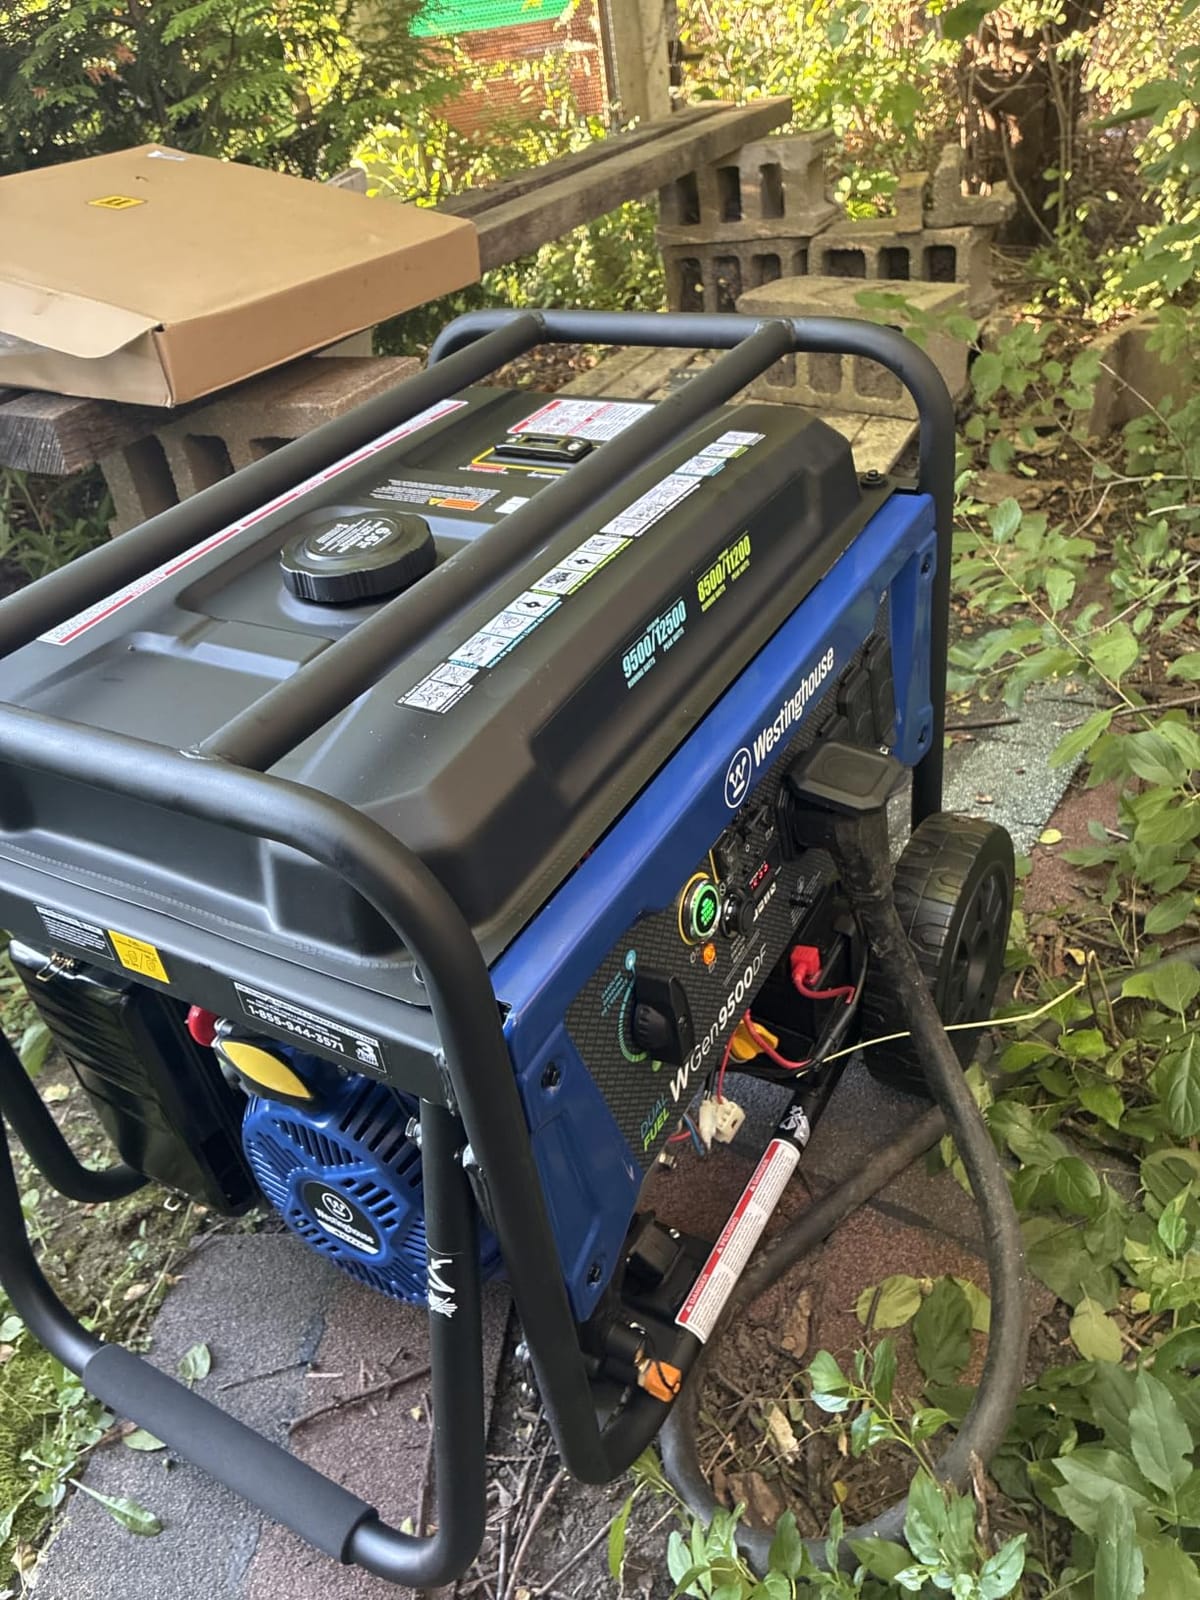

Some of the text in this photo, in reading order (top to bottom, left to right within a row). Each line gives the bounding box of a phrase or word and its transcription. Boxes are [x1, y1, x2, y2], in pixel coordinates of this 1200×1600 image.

[697, 535, 751, 602] 8500/11200
[622, 600, 687, 678] 9500/12500
[753, 647, 834, 767] Westinghouse
[248, 1004, 345, 1053] 1-855-944-3571
[669, 943, 767, 1103] WGen9500DF
[640, 1093, 668, 1138] DUAL
[643, 1108, 670, 1152] FUEL
[690, 1272, 709, 1306] DANGER
